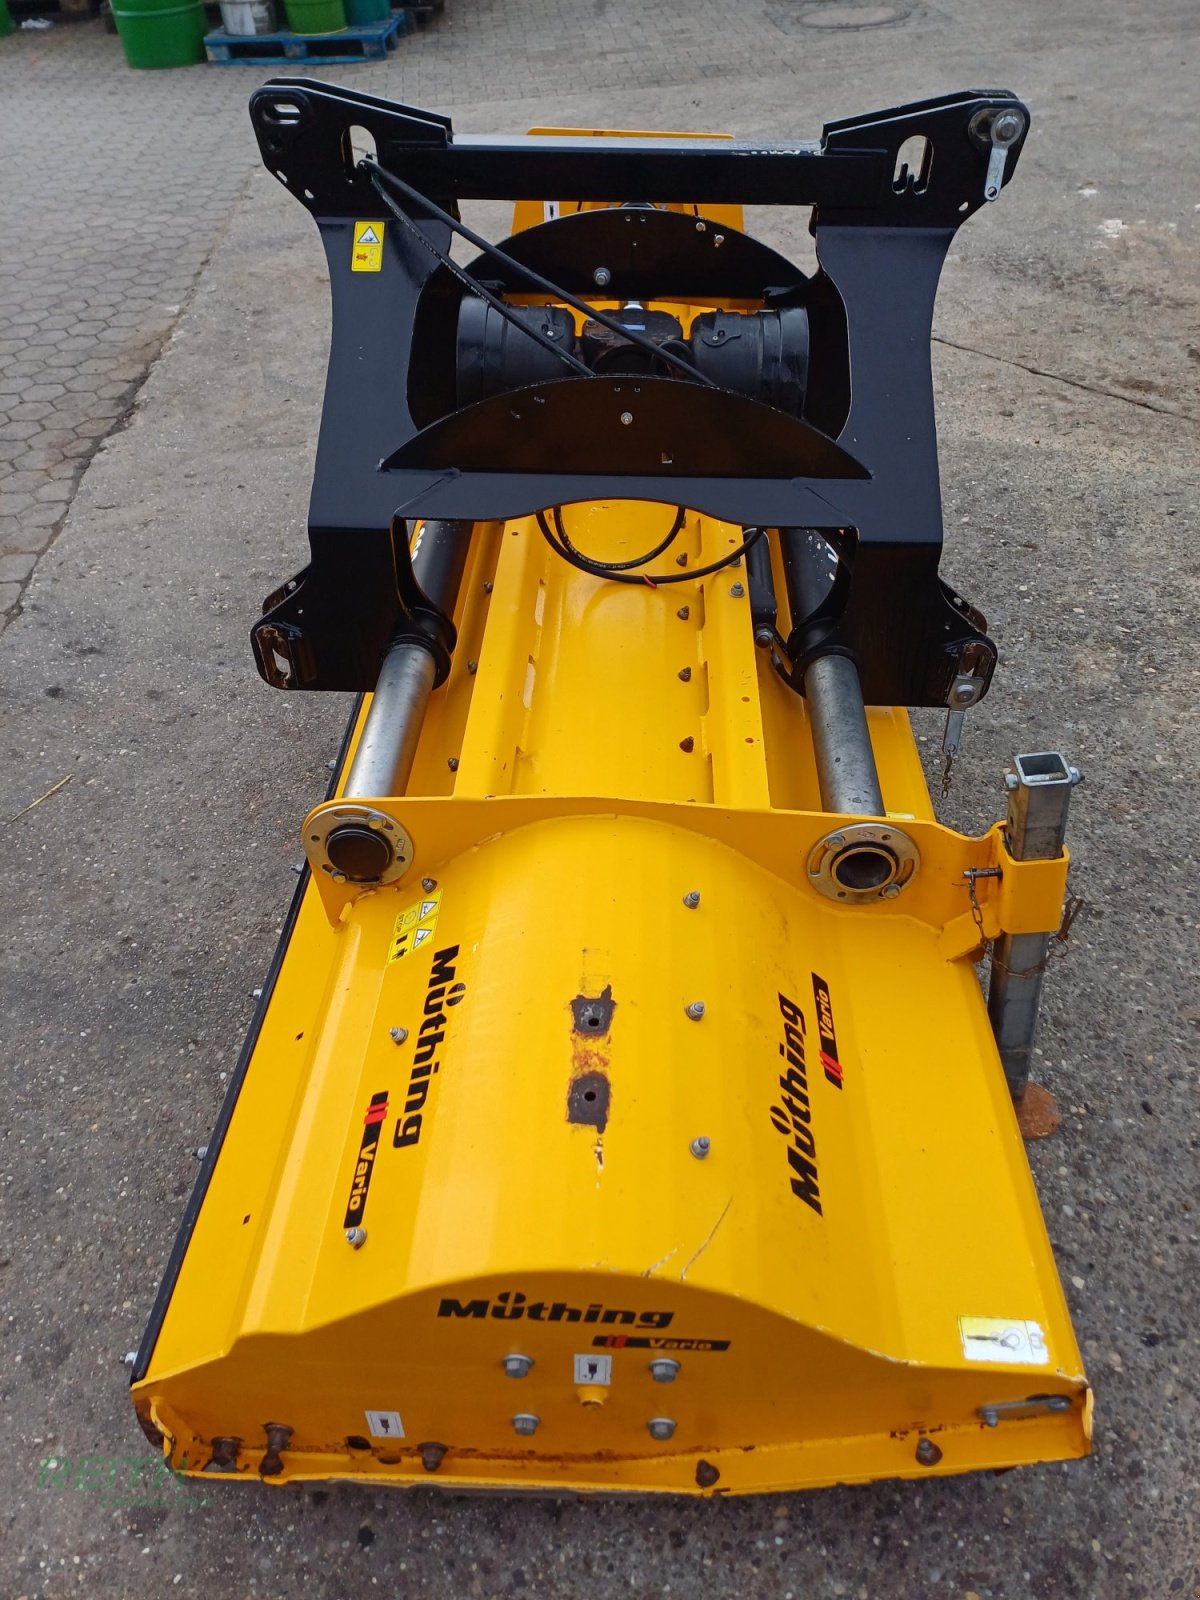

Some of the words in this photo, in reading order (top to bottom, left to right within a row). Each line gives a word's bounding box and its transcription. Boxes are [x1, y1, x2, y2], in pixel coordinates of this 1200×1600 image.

[817, 988, 835, 1041] Vario
[392, 944, 466, 1149] Müthing
[770, 992, 823, 1216] Müthing
[348, 1141, 377, 1212] Vario
[437, 1291, 675, 1329] Müthing
[647, 1336, 713, 1351] Vario
